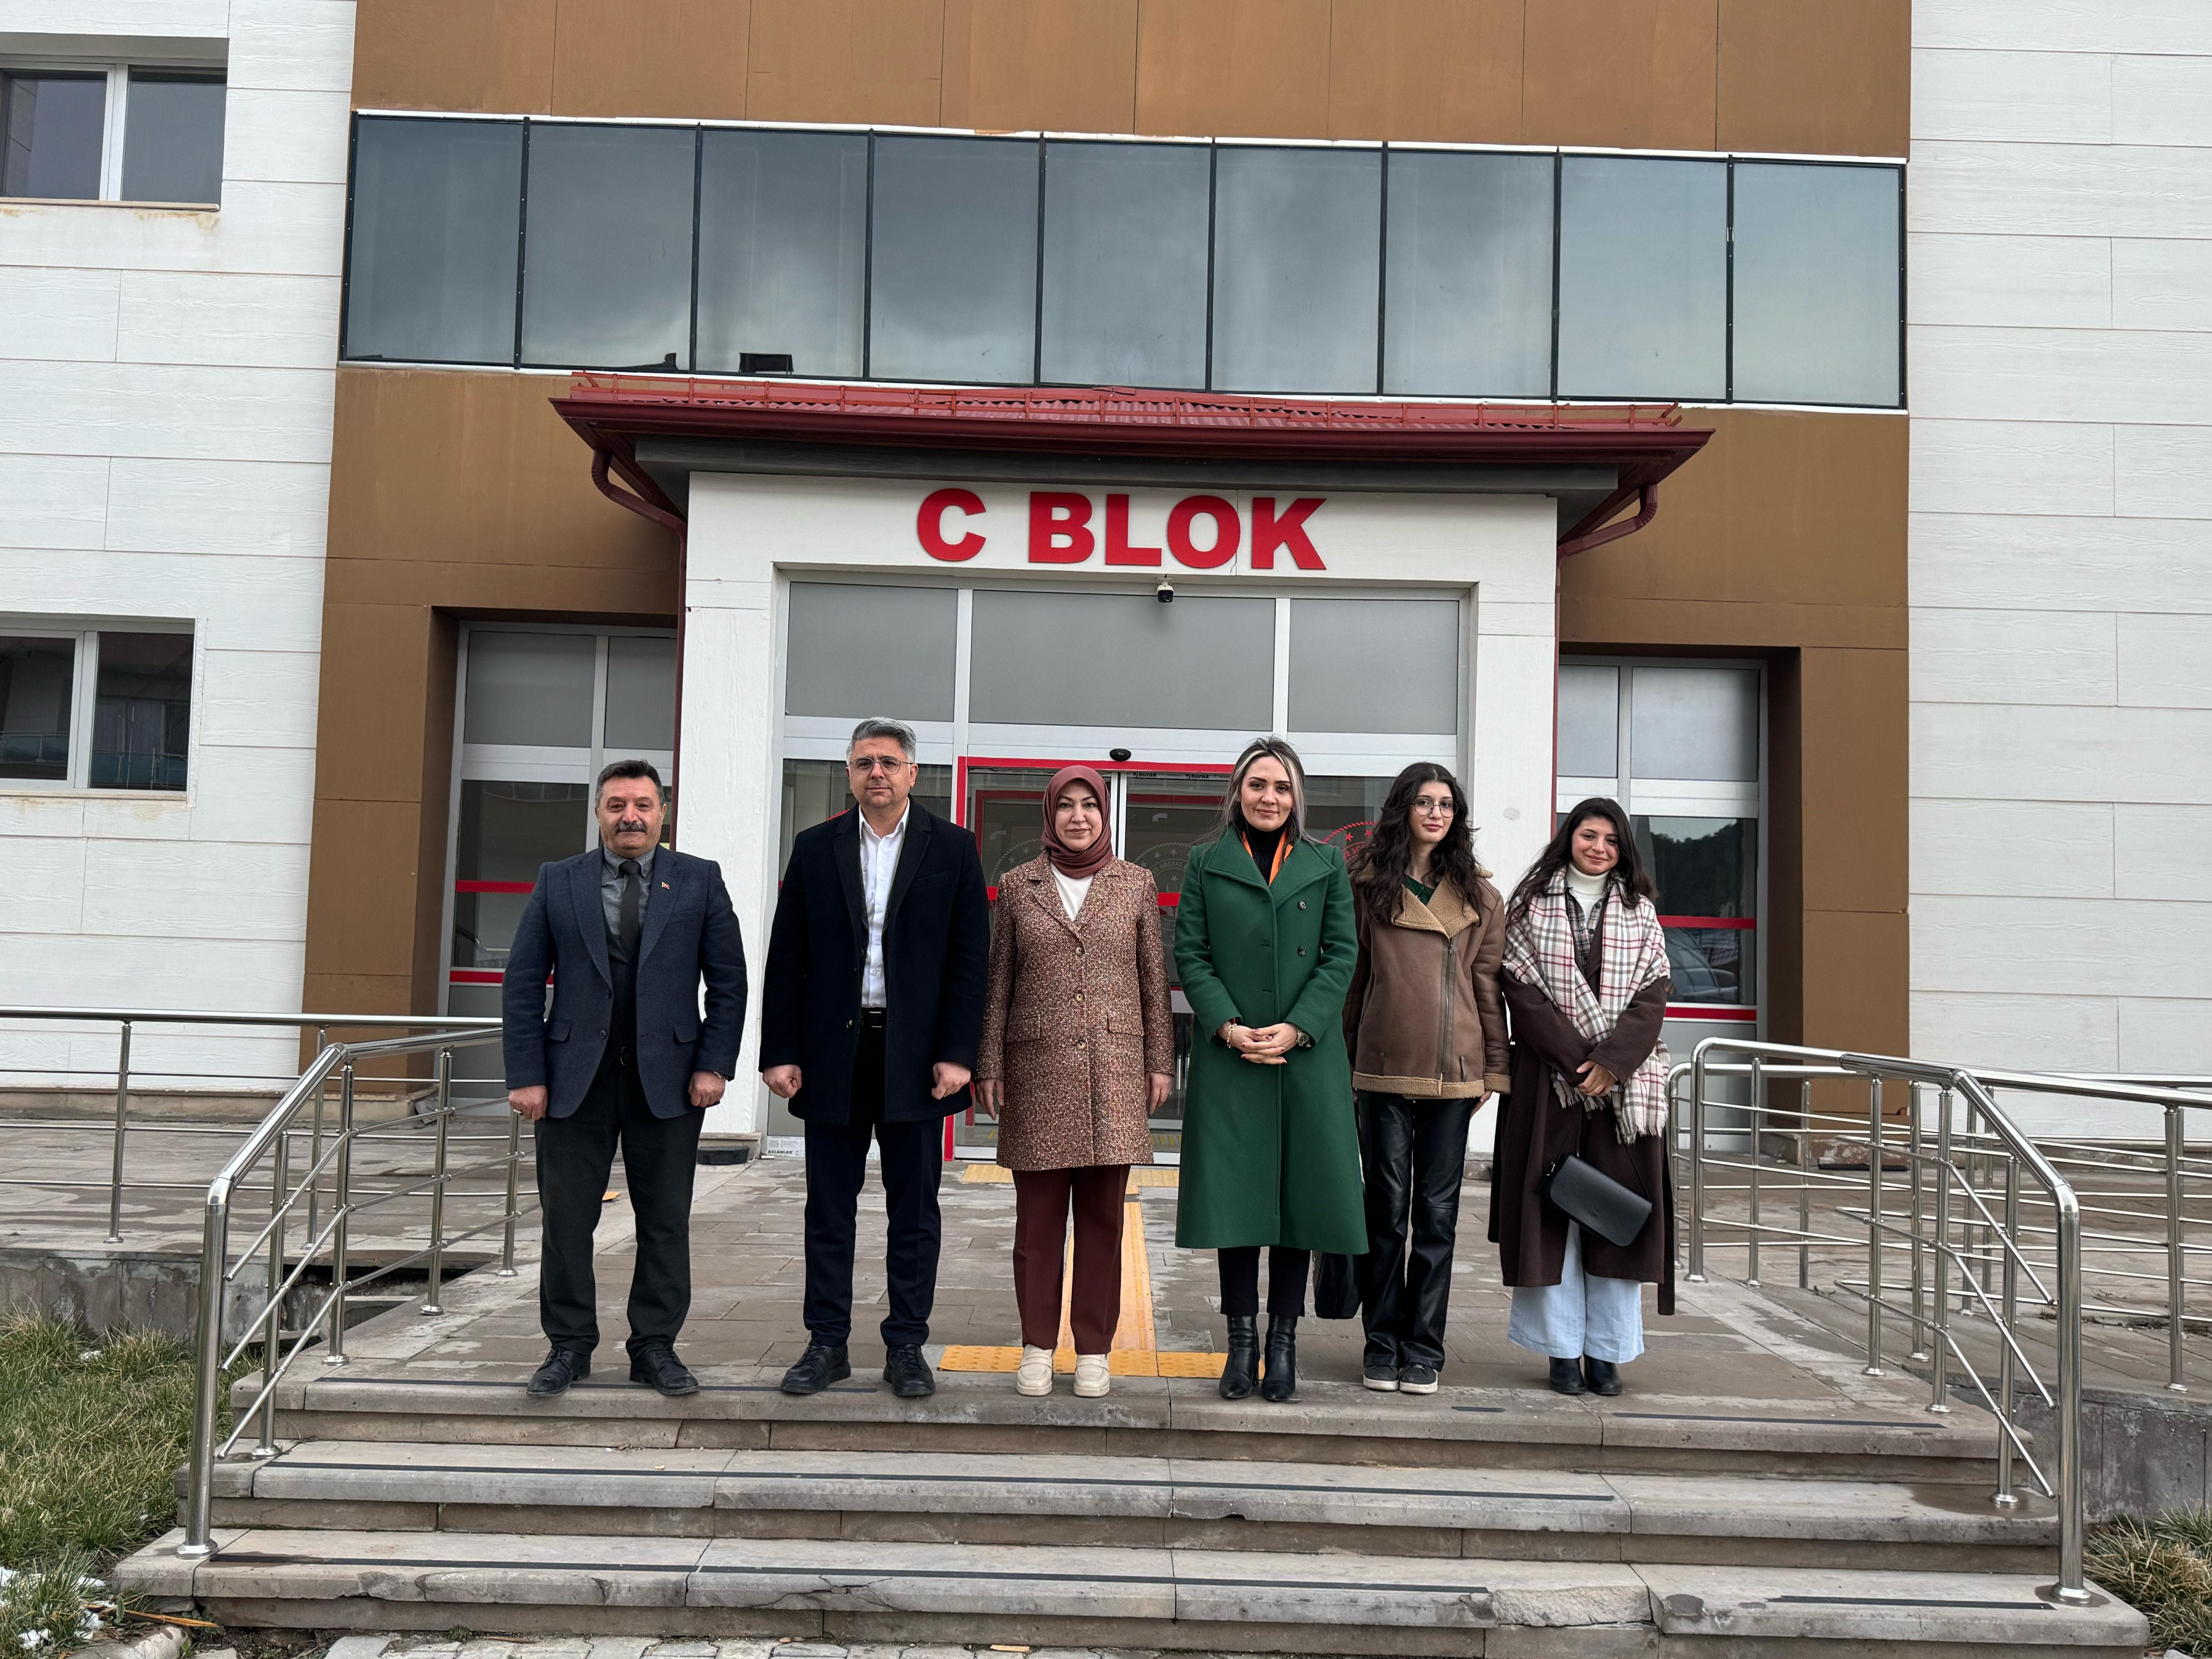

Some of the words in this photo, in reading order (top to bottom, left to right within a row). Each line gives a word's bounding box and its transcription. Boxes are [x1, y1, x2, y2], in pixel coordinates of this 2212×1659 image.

[917, 496, 986, 562] C
[1028, 499, 1326, 570] BLOK
[1159, 861, 1182, 869] SOSYAL
